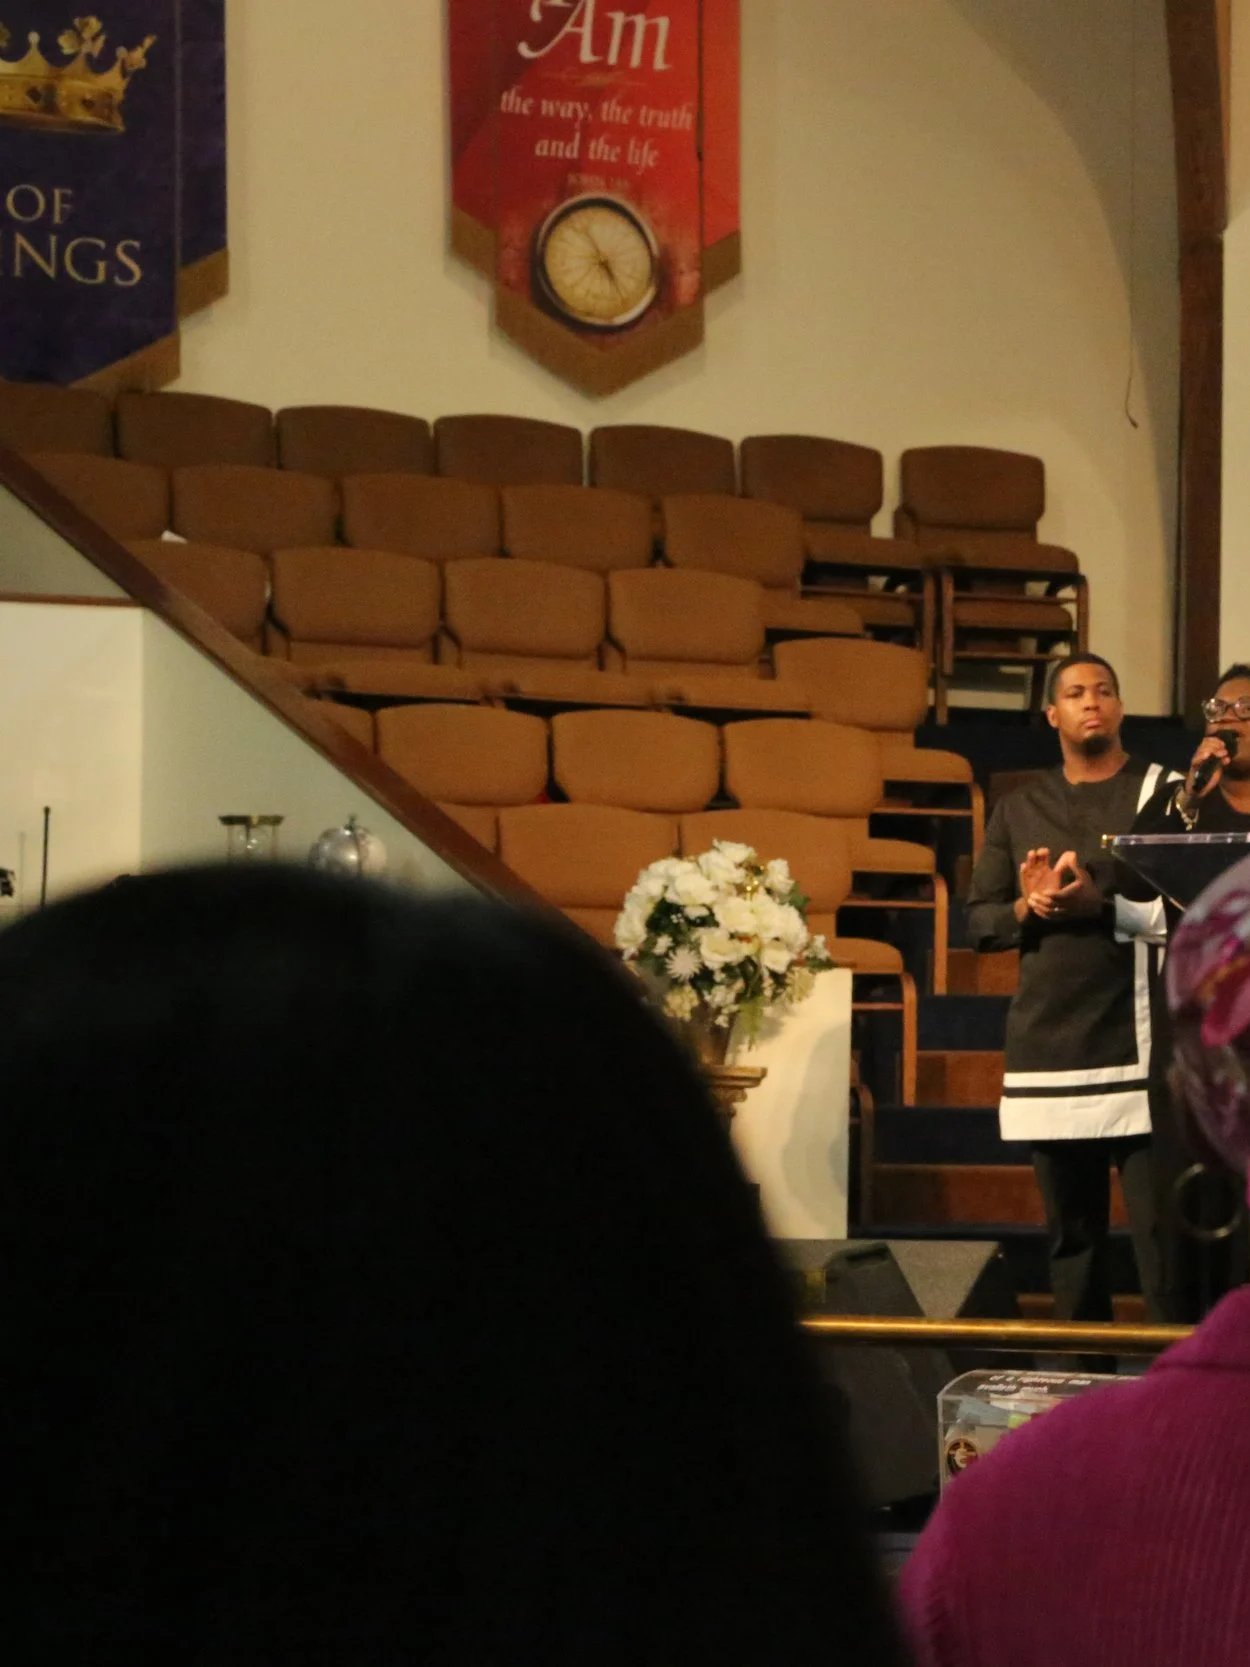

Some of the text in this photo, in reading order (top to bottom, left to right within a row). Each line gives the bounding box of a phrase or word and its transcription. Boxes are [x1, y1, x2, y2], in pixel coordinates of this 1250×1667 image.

[517, 0, 673, 72] Am
[500, 86, 534, 116] the
[601, 92, 633, 125] the
[639, 102, 695, 131] truth
[535, 131, 660, 176] and the life
[5, 183, 74, 225] OF
[0, 231, 143, 287] NGS
